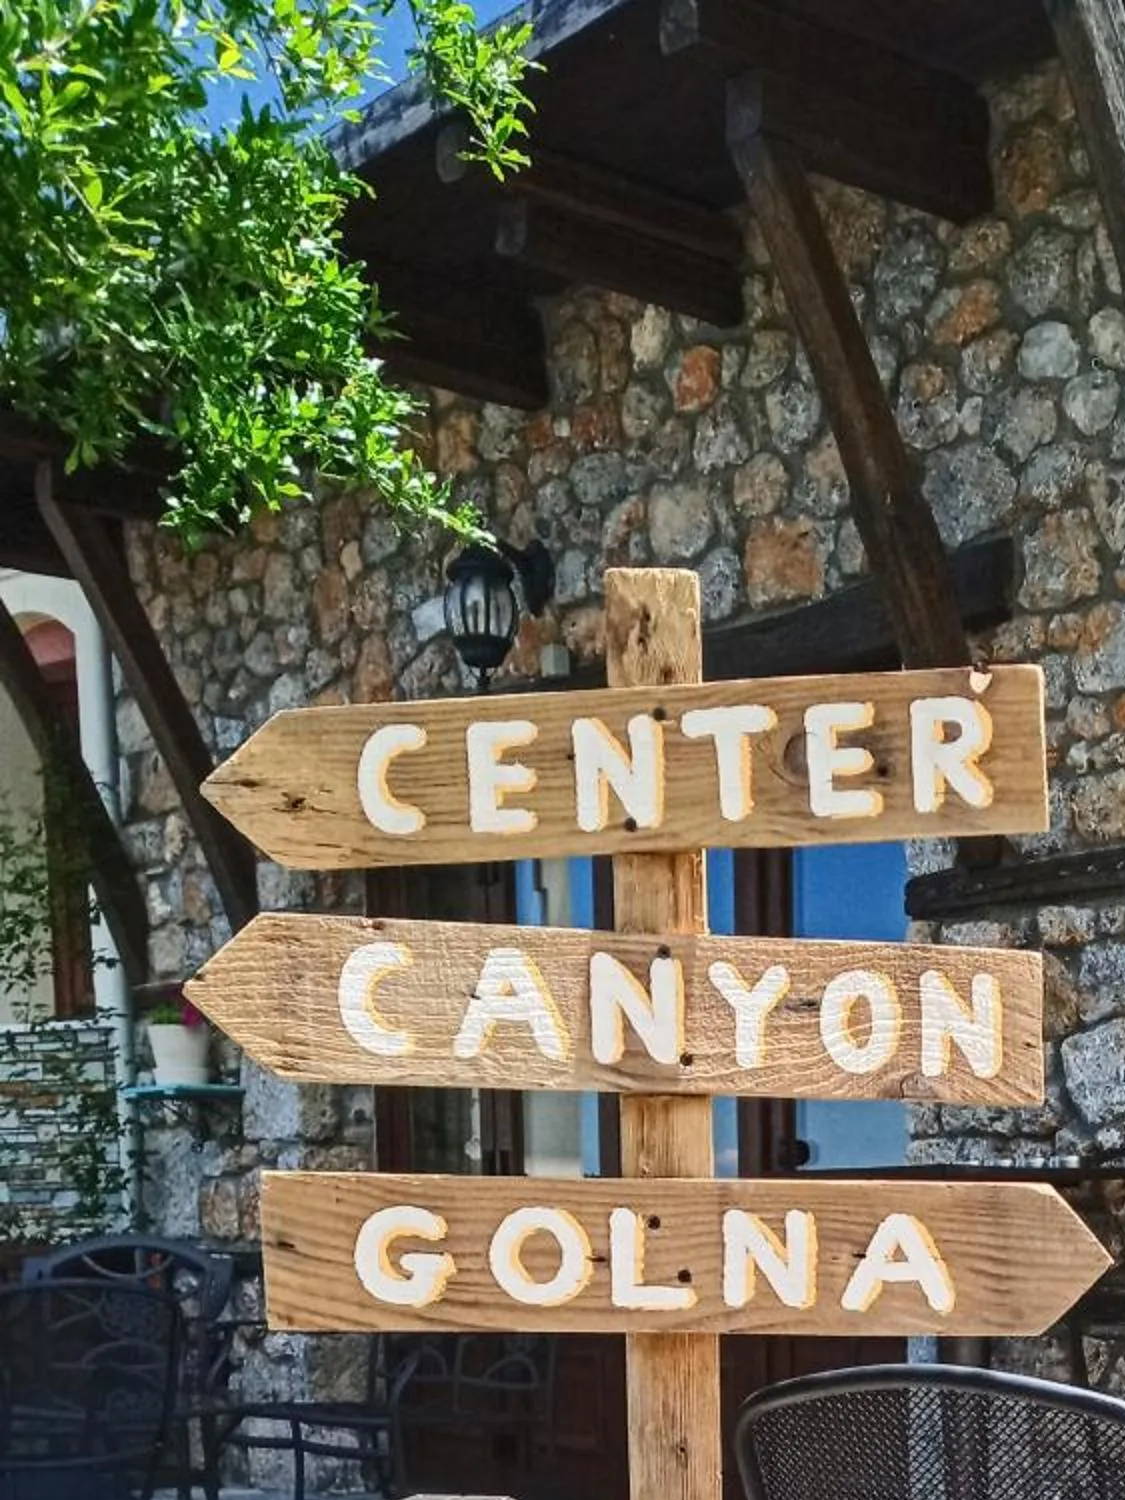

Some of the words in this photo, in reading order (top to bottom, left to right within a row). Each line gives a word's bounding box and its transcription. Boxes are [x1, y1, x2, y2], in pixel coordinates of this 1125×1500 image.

[356, 696, 995, 836] CENTER
[337, 940, 1003, 1080] CANYON
[353, 1205, 957, 1315] GOLNA
